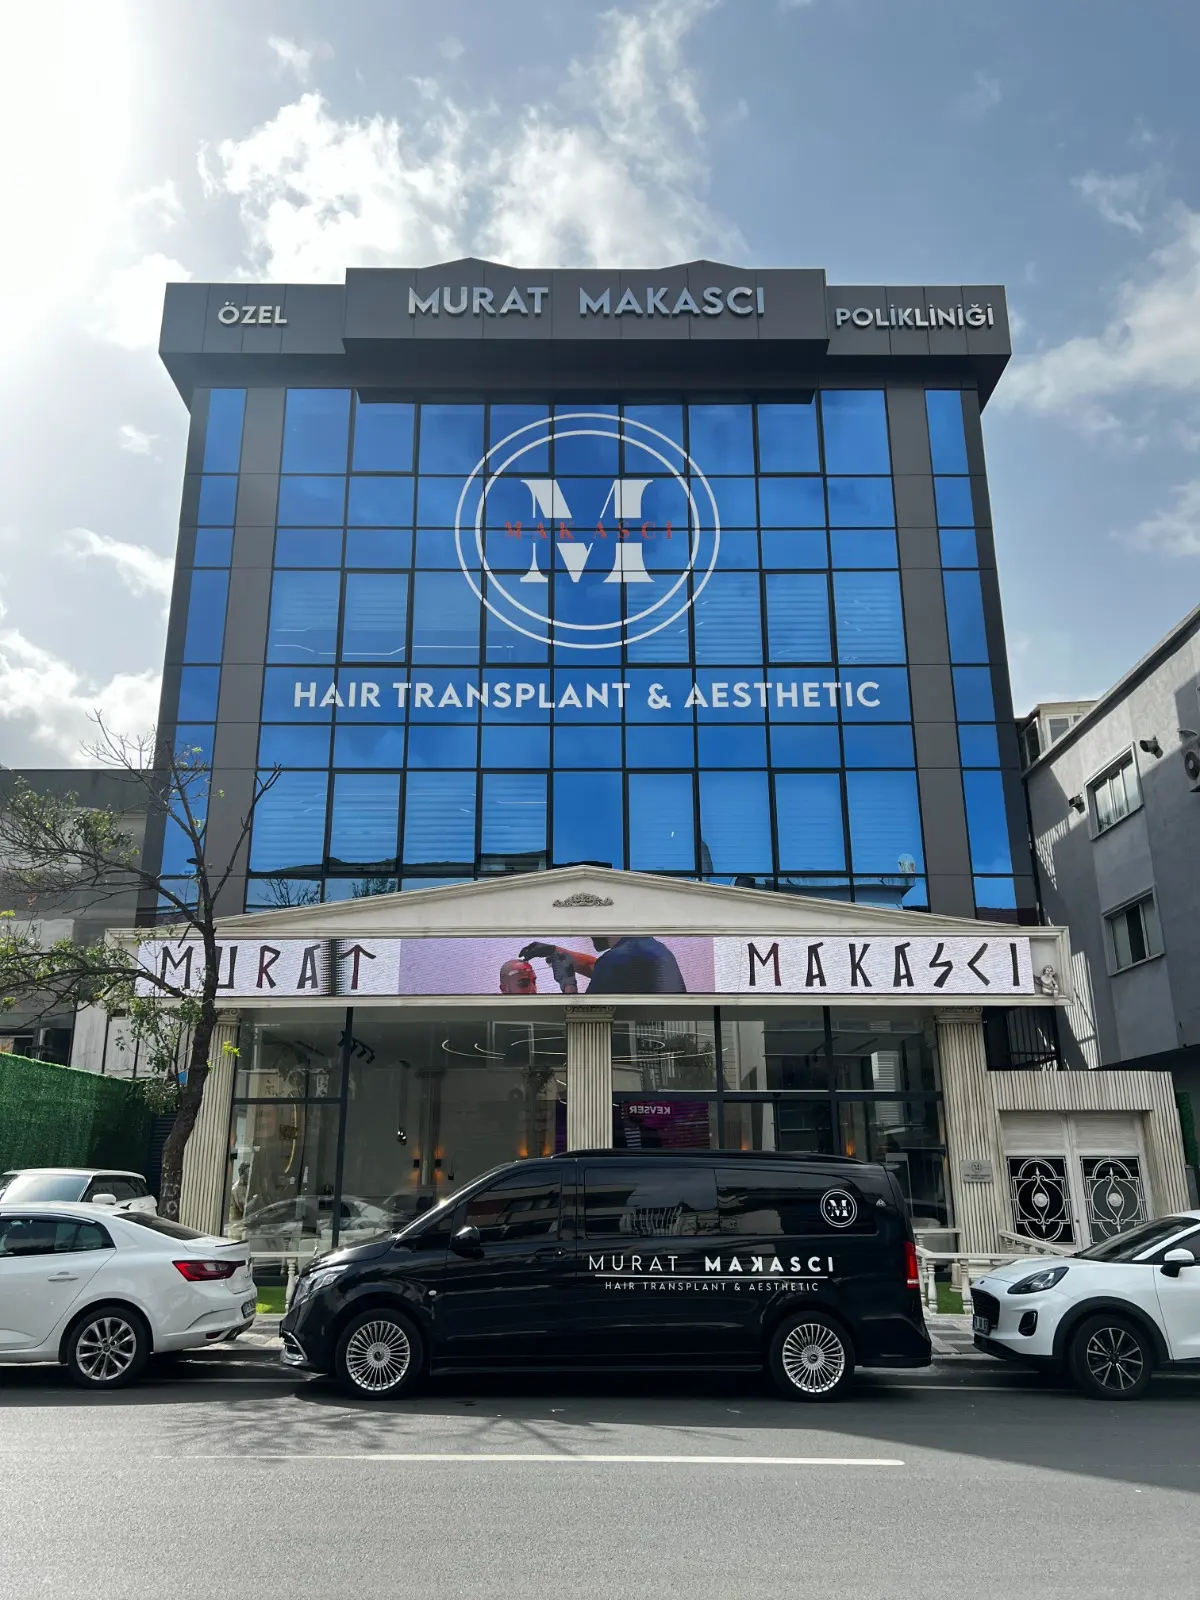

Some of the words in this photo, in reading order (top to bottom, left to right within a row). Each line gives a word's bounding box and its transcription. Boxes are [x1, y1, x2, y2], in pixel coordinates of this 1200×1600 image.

[218, 302, 287, 325] ÖZEL
[408, 286, 549, 316] MURAT
[578, 286, 765, 317] MAKASCI
[835, 303, 995, 329] POLİKLİNİĞİ
[520, 479, 655, 582] M
[293, 682, 381, 708] HAIR
[392, 682, 631, 709] TRANSPLANT
[647, 683, 671, 709] &
[684, 681, 881, 708] AESTHETIC
[160, 944, 377, 990] MURAT
[747, 942, 1020, 988] MAKASCI
[588, 1255, 679, 1272] MURAT
[704, 1256, 835, 1273] MAKASCI
[605, 1281, 635, 1291] HAIR
[643, 1281, 727, 1292] TRANSPLANT
[734, 1282, 741, 1292] &
[749, 1282, 819, 1292] AESTHETIC
